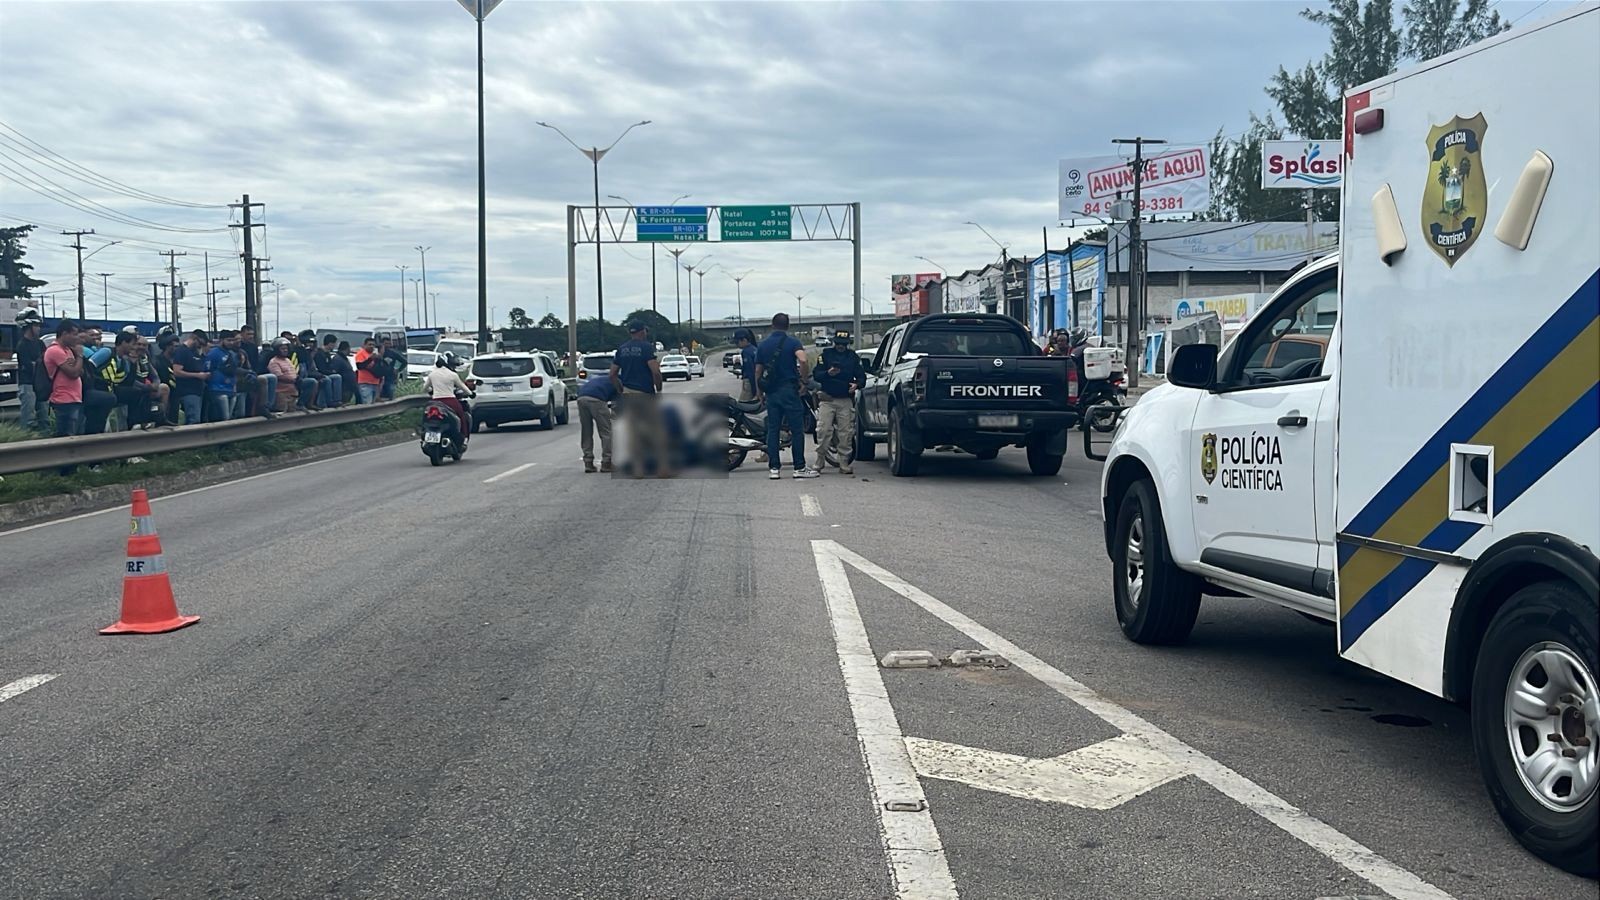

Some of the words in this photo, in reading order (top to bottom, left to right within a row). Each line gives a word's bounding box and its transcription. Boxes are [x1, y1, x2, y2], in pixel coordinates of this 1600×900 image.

[1444, 130, 1467, 148] POLÍCIA
[1163, 154, 1201, 178] AQUI
[1269, 154, 1342, 179] Splas
[1084, 202, 1101, 215] 84
[1104, 197, 1184, 214] 99-3381
[1254, 233, 1338, 251] TRATAE
[1437, 231, 1467, 246] CIENTÍFICA
[950, 385, 1042, 397] FRONTIER
[1221, 430, 1283, 465] POLÍCIA
[1221, 465, 1284, 491] CIENTÍFICA
